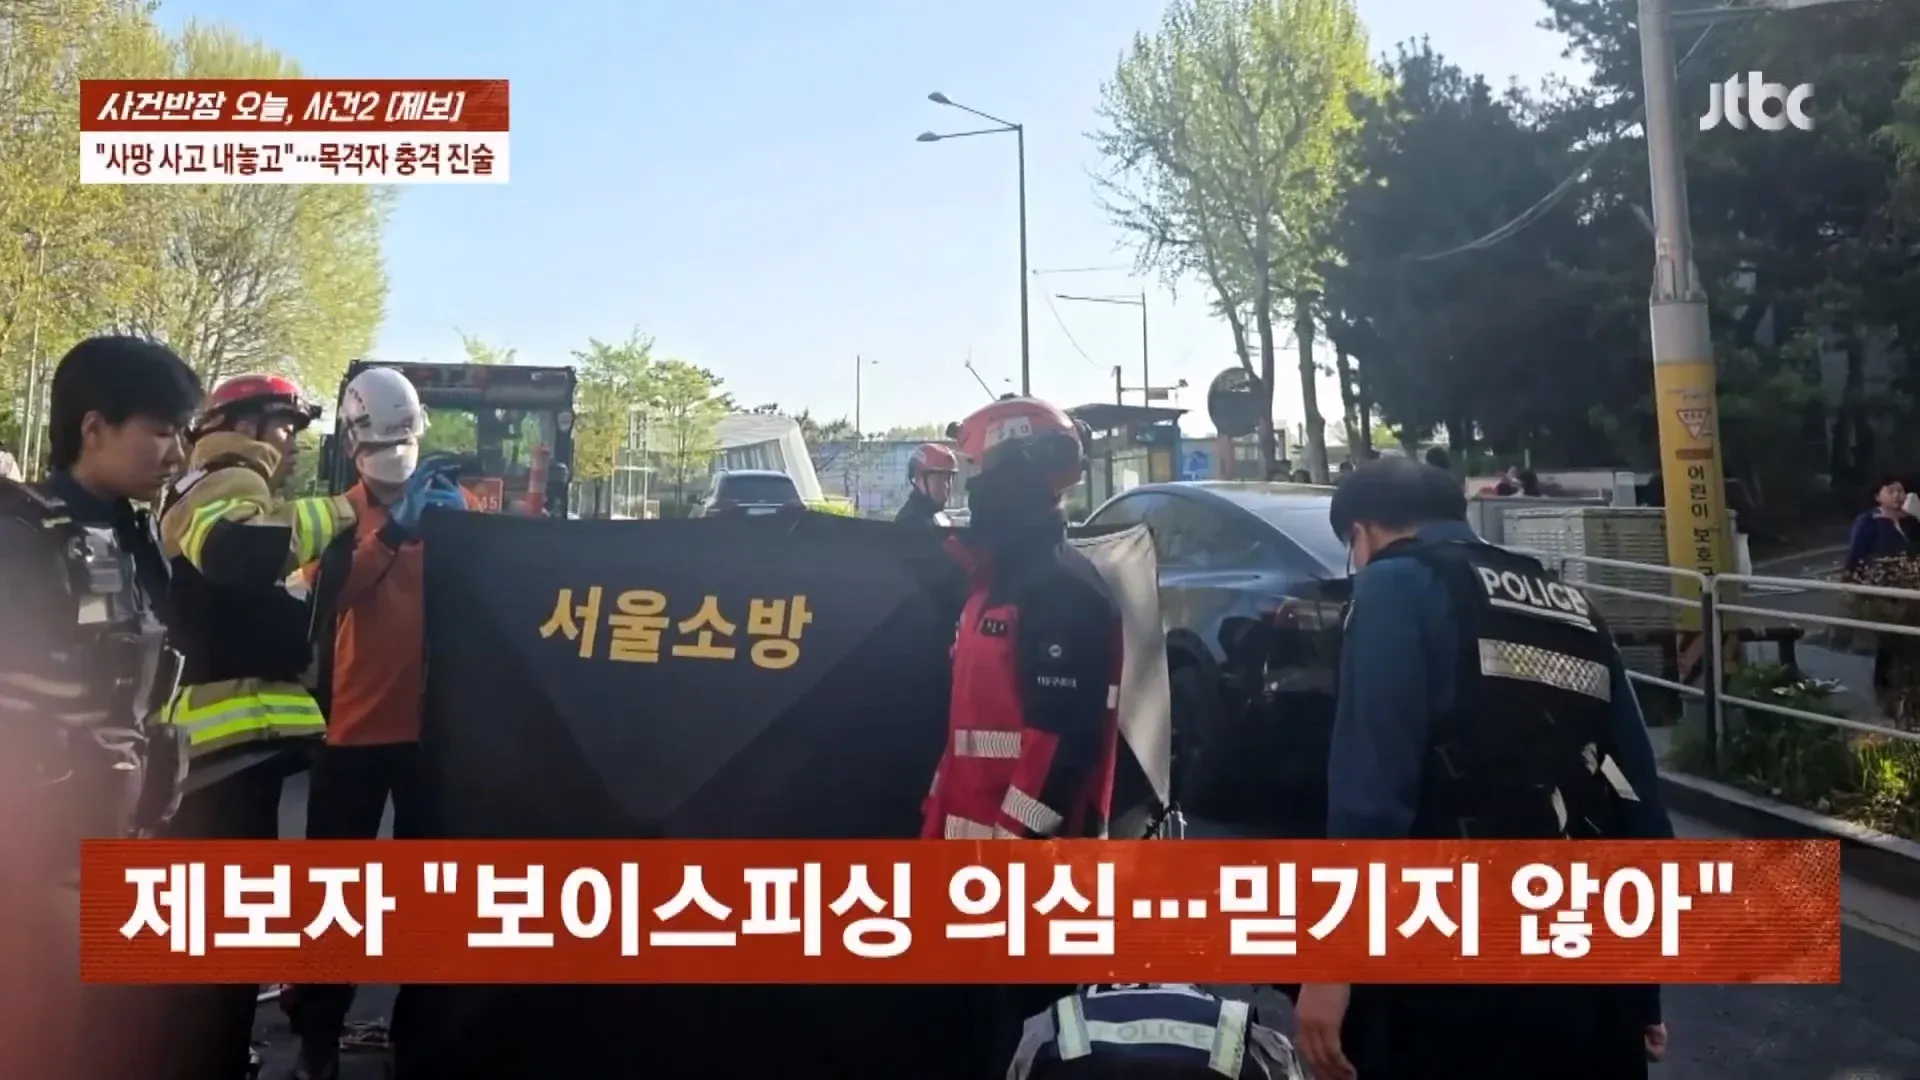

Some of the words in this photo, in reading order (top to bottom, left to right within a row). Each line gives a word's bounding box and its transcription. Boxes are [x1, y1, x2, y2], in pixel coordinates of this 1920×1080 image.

[1687, 466, 1709, 519] 어린이
[1694, 527, 1716, 592] 보호구
[1477, 566, 1589, 616] POLICE
[539, 586, 812, 669] 서울소방
